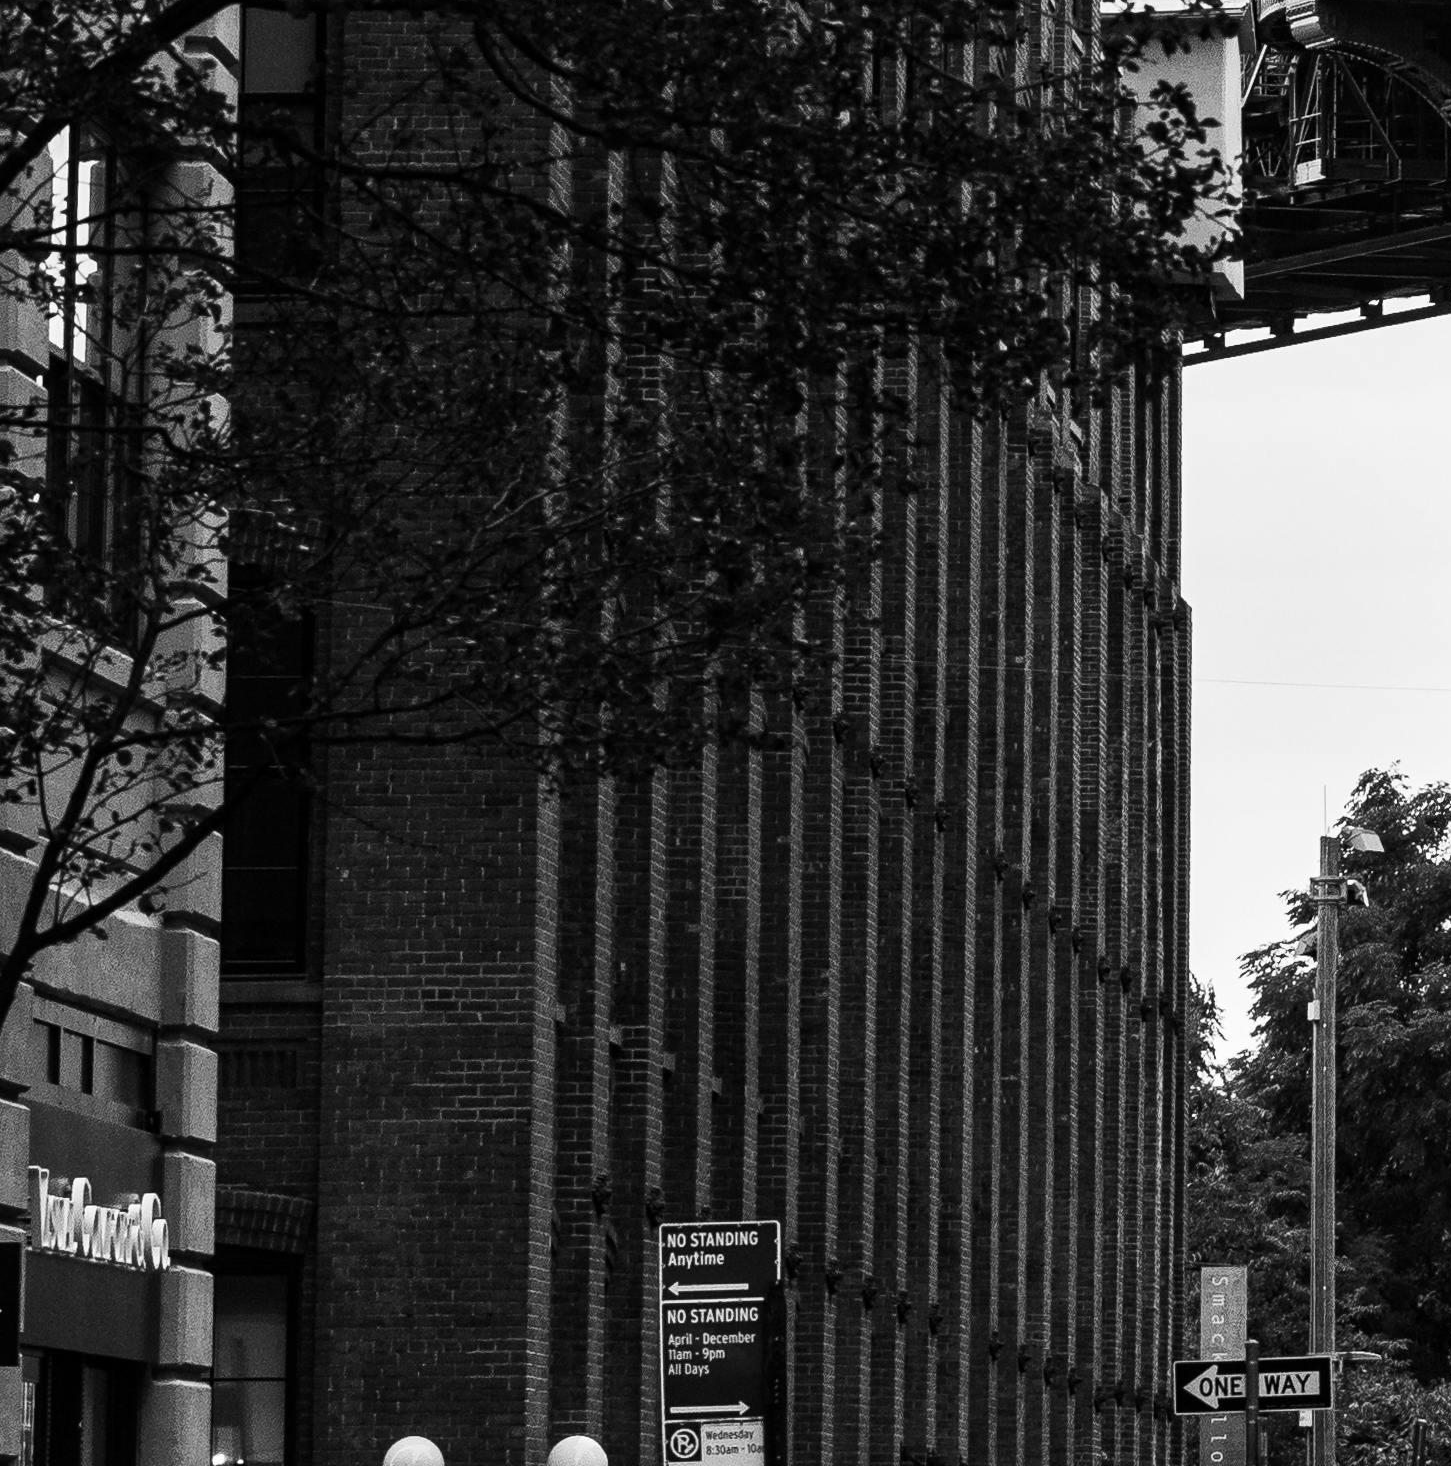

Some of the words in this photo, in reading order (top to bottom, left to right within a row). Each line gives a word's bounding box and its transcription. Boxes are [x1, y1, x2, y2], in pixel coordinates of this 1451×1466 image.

[667, 1233, 687, 1248] NO
[690, 1231, 759, 1248] STANDING
[668, 1251, 725, 1269] Anytime
[667, 1309, 687, 1324] NO
[690, 1307, 759, 1324] STANDING
[668, 1333, 693, 1347] April
[702, 1331, 756, 1345] December
[668, 1349, 692, 1360] 11am
[702, 1348, 726, 1361] 9pm
[668, 1364, 682, 1375] All
[684, 1363, 710, 1377] Days
[1199, 1376, 1243, 1398] ONE
[1264, 1373, 1311, 1395] WAY
[705, 1429, 754, 1441] Wednesday
[705, 1445, 739, 1456] 8:30am
[747, 1443, 763, 1454] 10a
